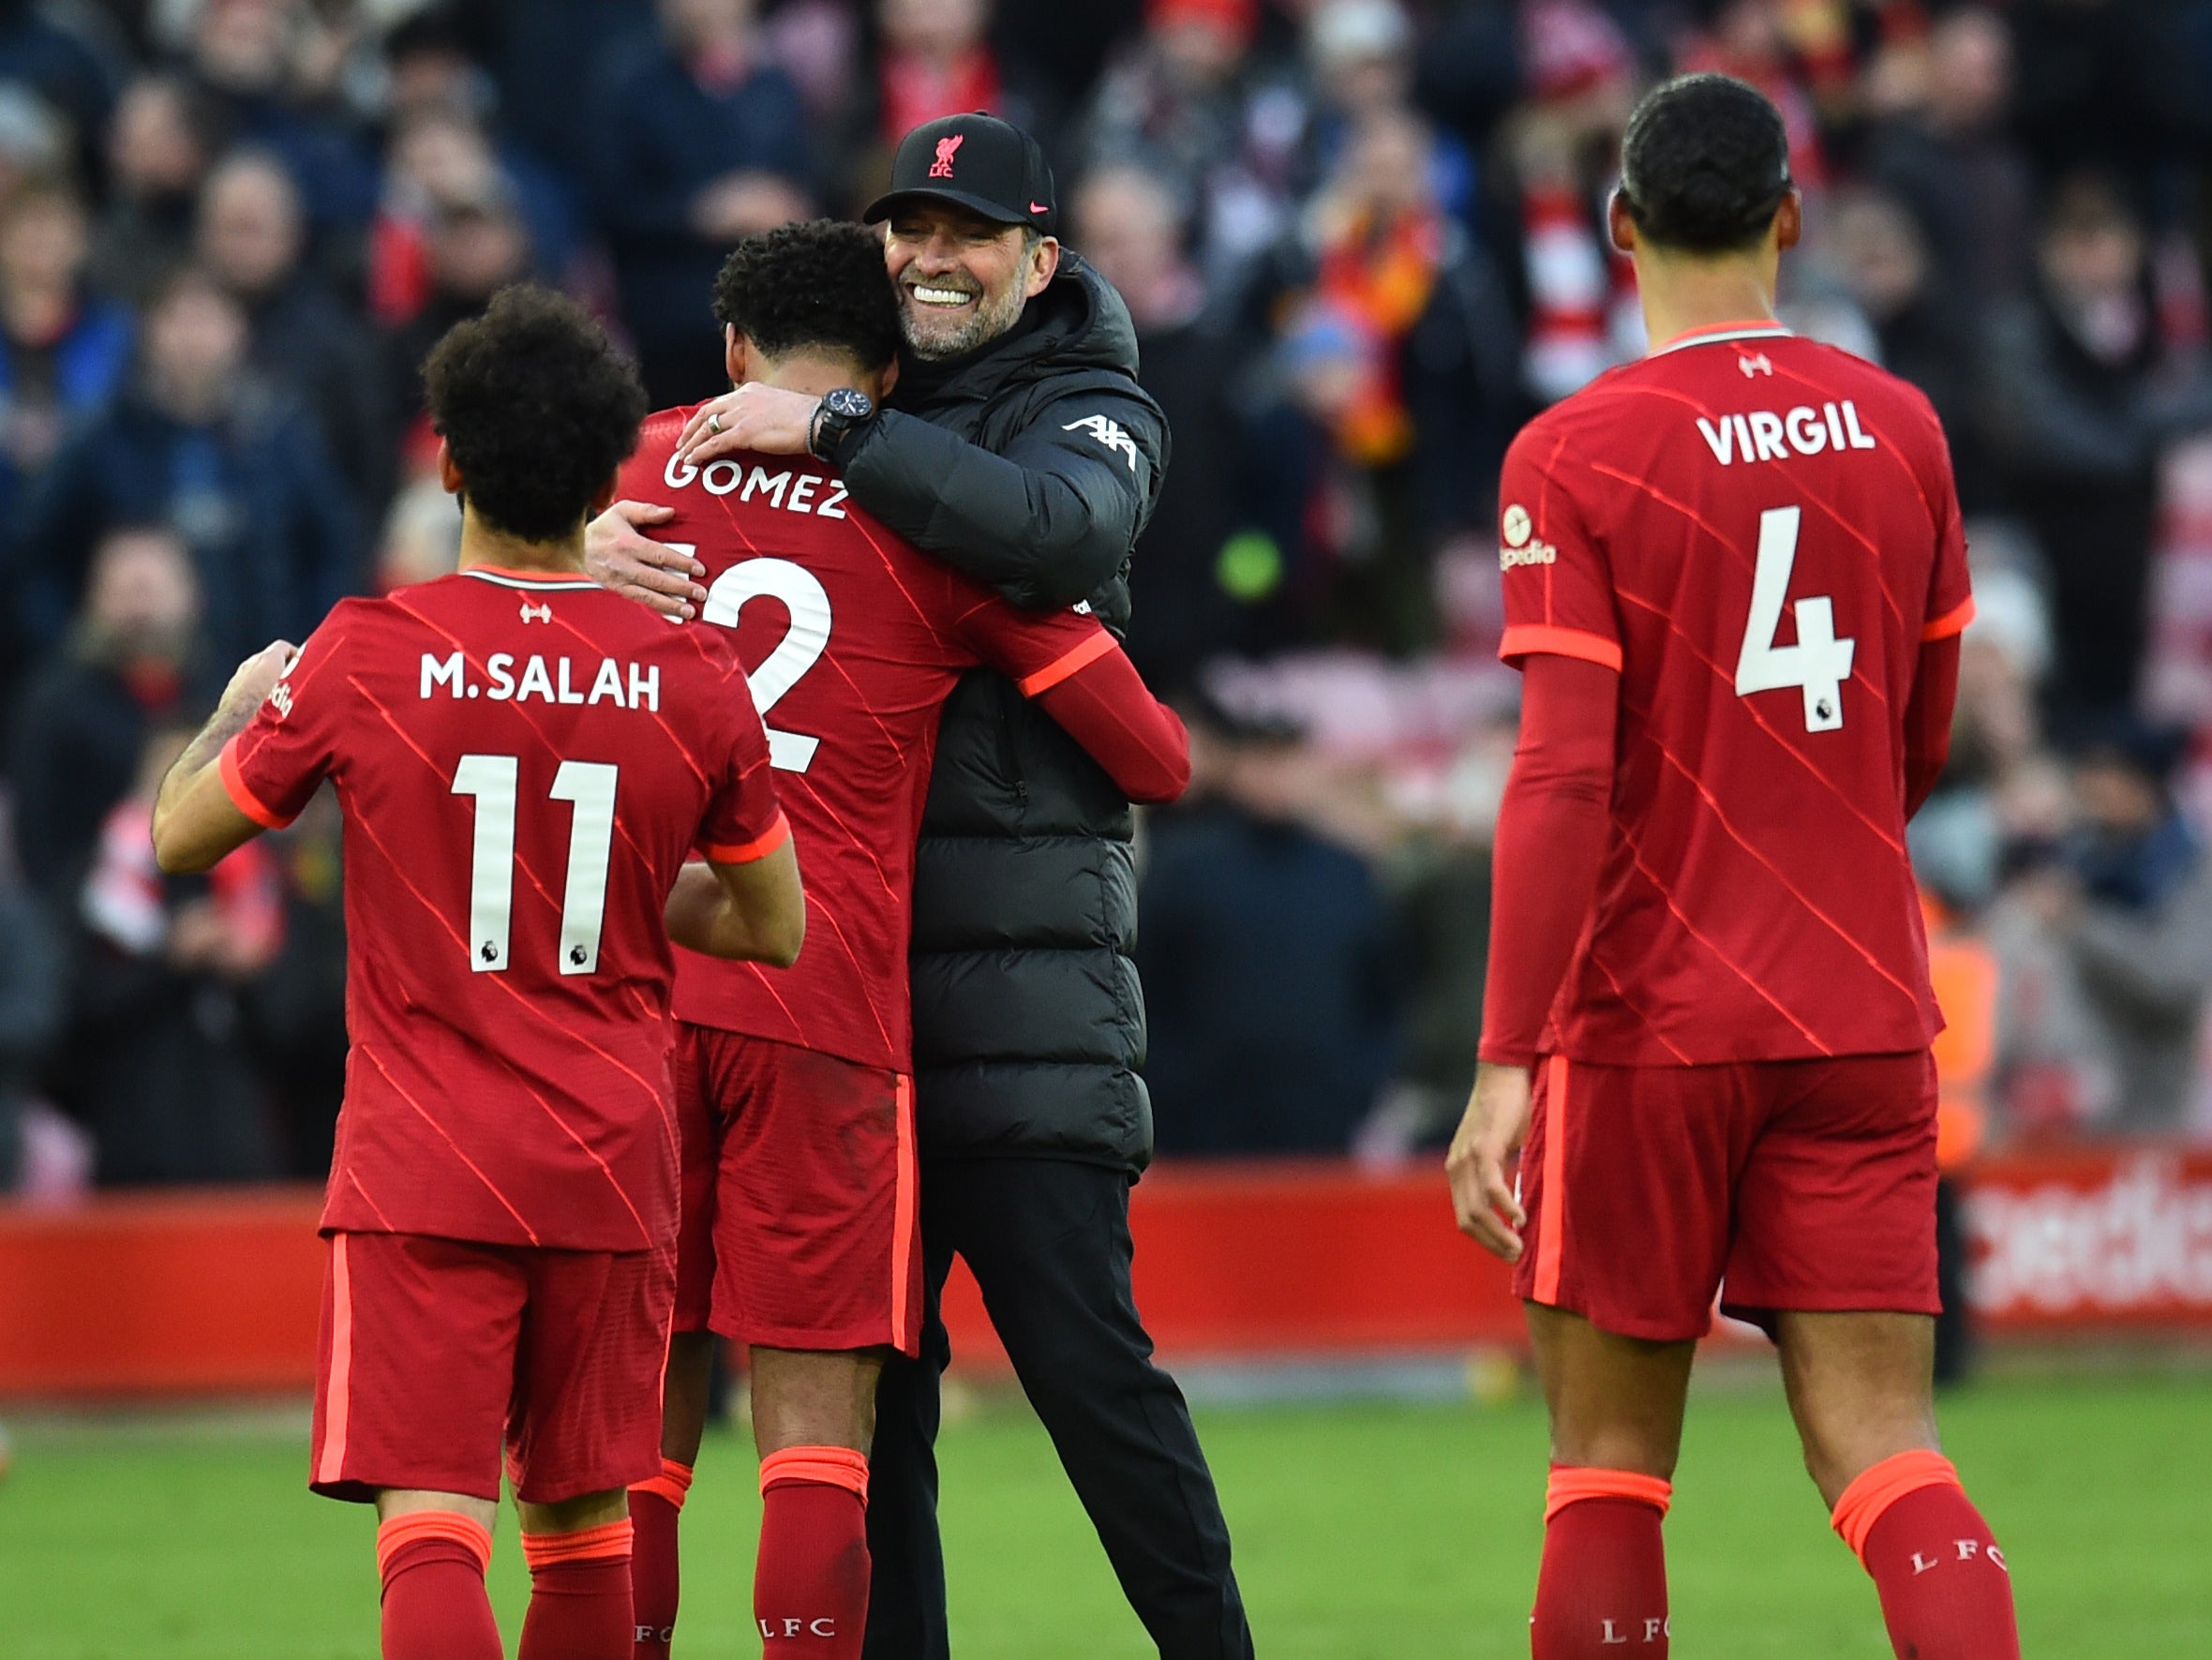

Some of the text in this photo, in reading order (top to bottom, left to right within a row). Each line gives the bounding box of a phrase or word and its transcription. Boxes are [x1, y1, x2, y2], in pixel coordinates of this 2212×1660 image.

[1696, 400, 1876, 466] VIRGIL
[664, 451, 849, 519] GOMEZ
[1735, 504, 1856, 733] 4
[420, 651, 660, 712] M.SALAH
[450, 754, 619, 976] 11
[759, 1617, 836, 1638] LFC
